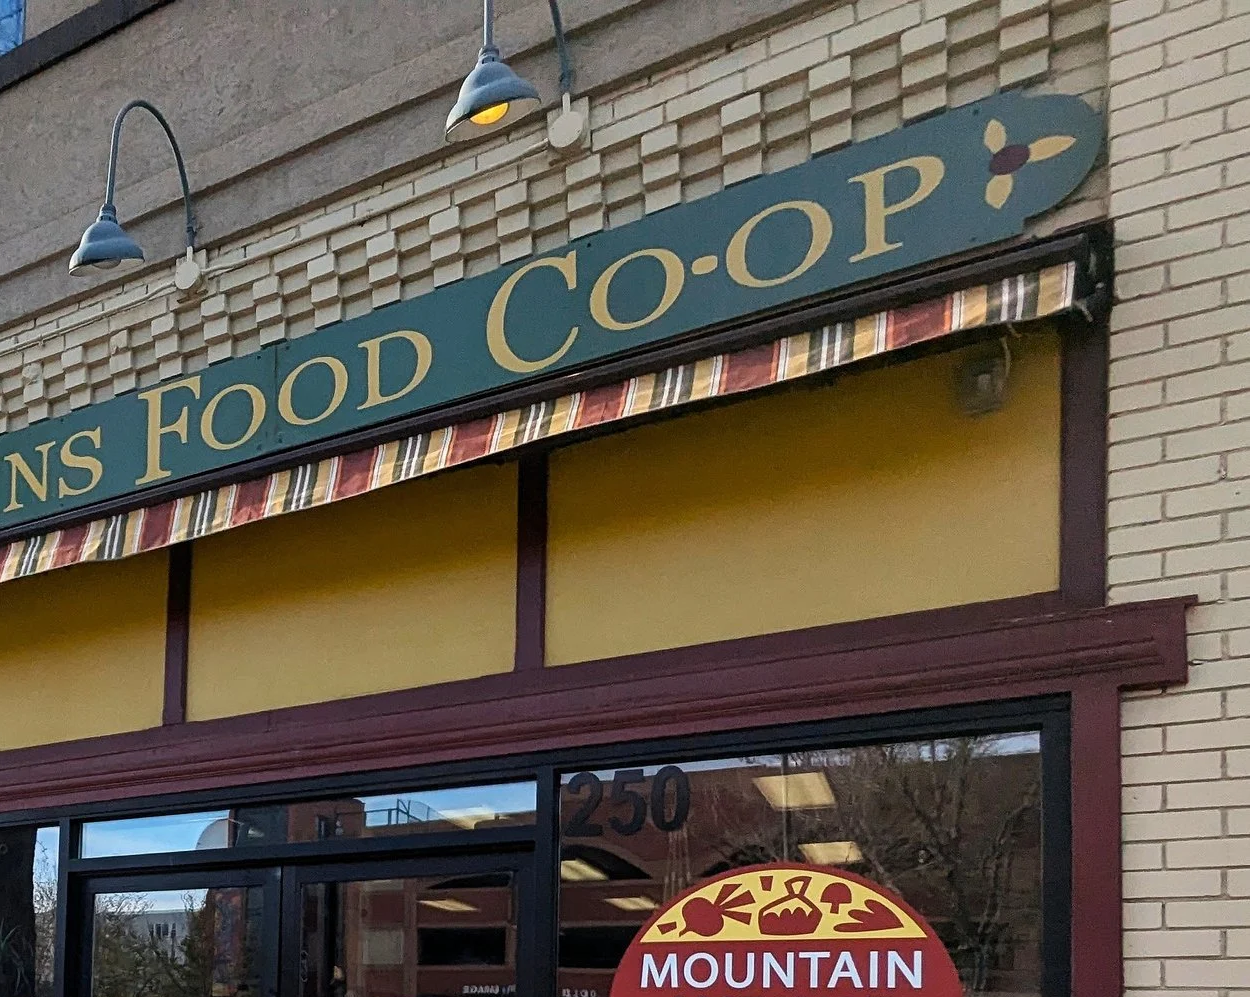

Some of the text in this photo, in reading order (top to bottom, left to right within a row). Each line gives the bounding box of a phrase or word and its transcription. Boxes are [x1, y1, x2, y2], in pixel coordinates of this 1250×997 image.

[135, 330, 434, 487] FOOD
[486, 154, 946, 373] CO-OP
[564, 765, 690, 837] 250
[640, 950, 922, 989] MOUNTAIN
